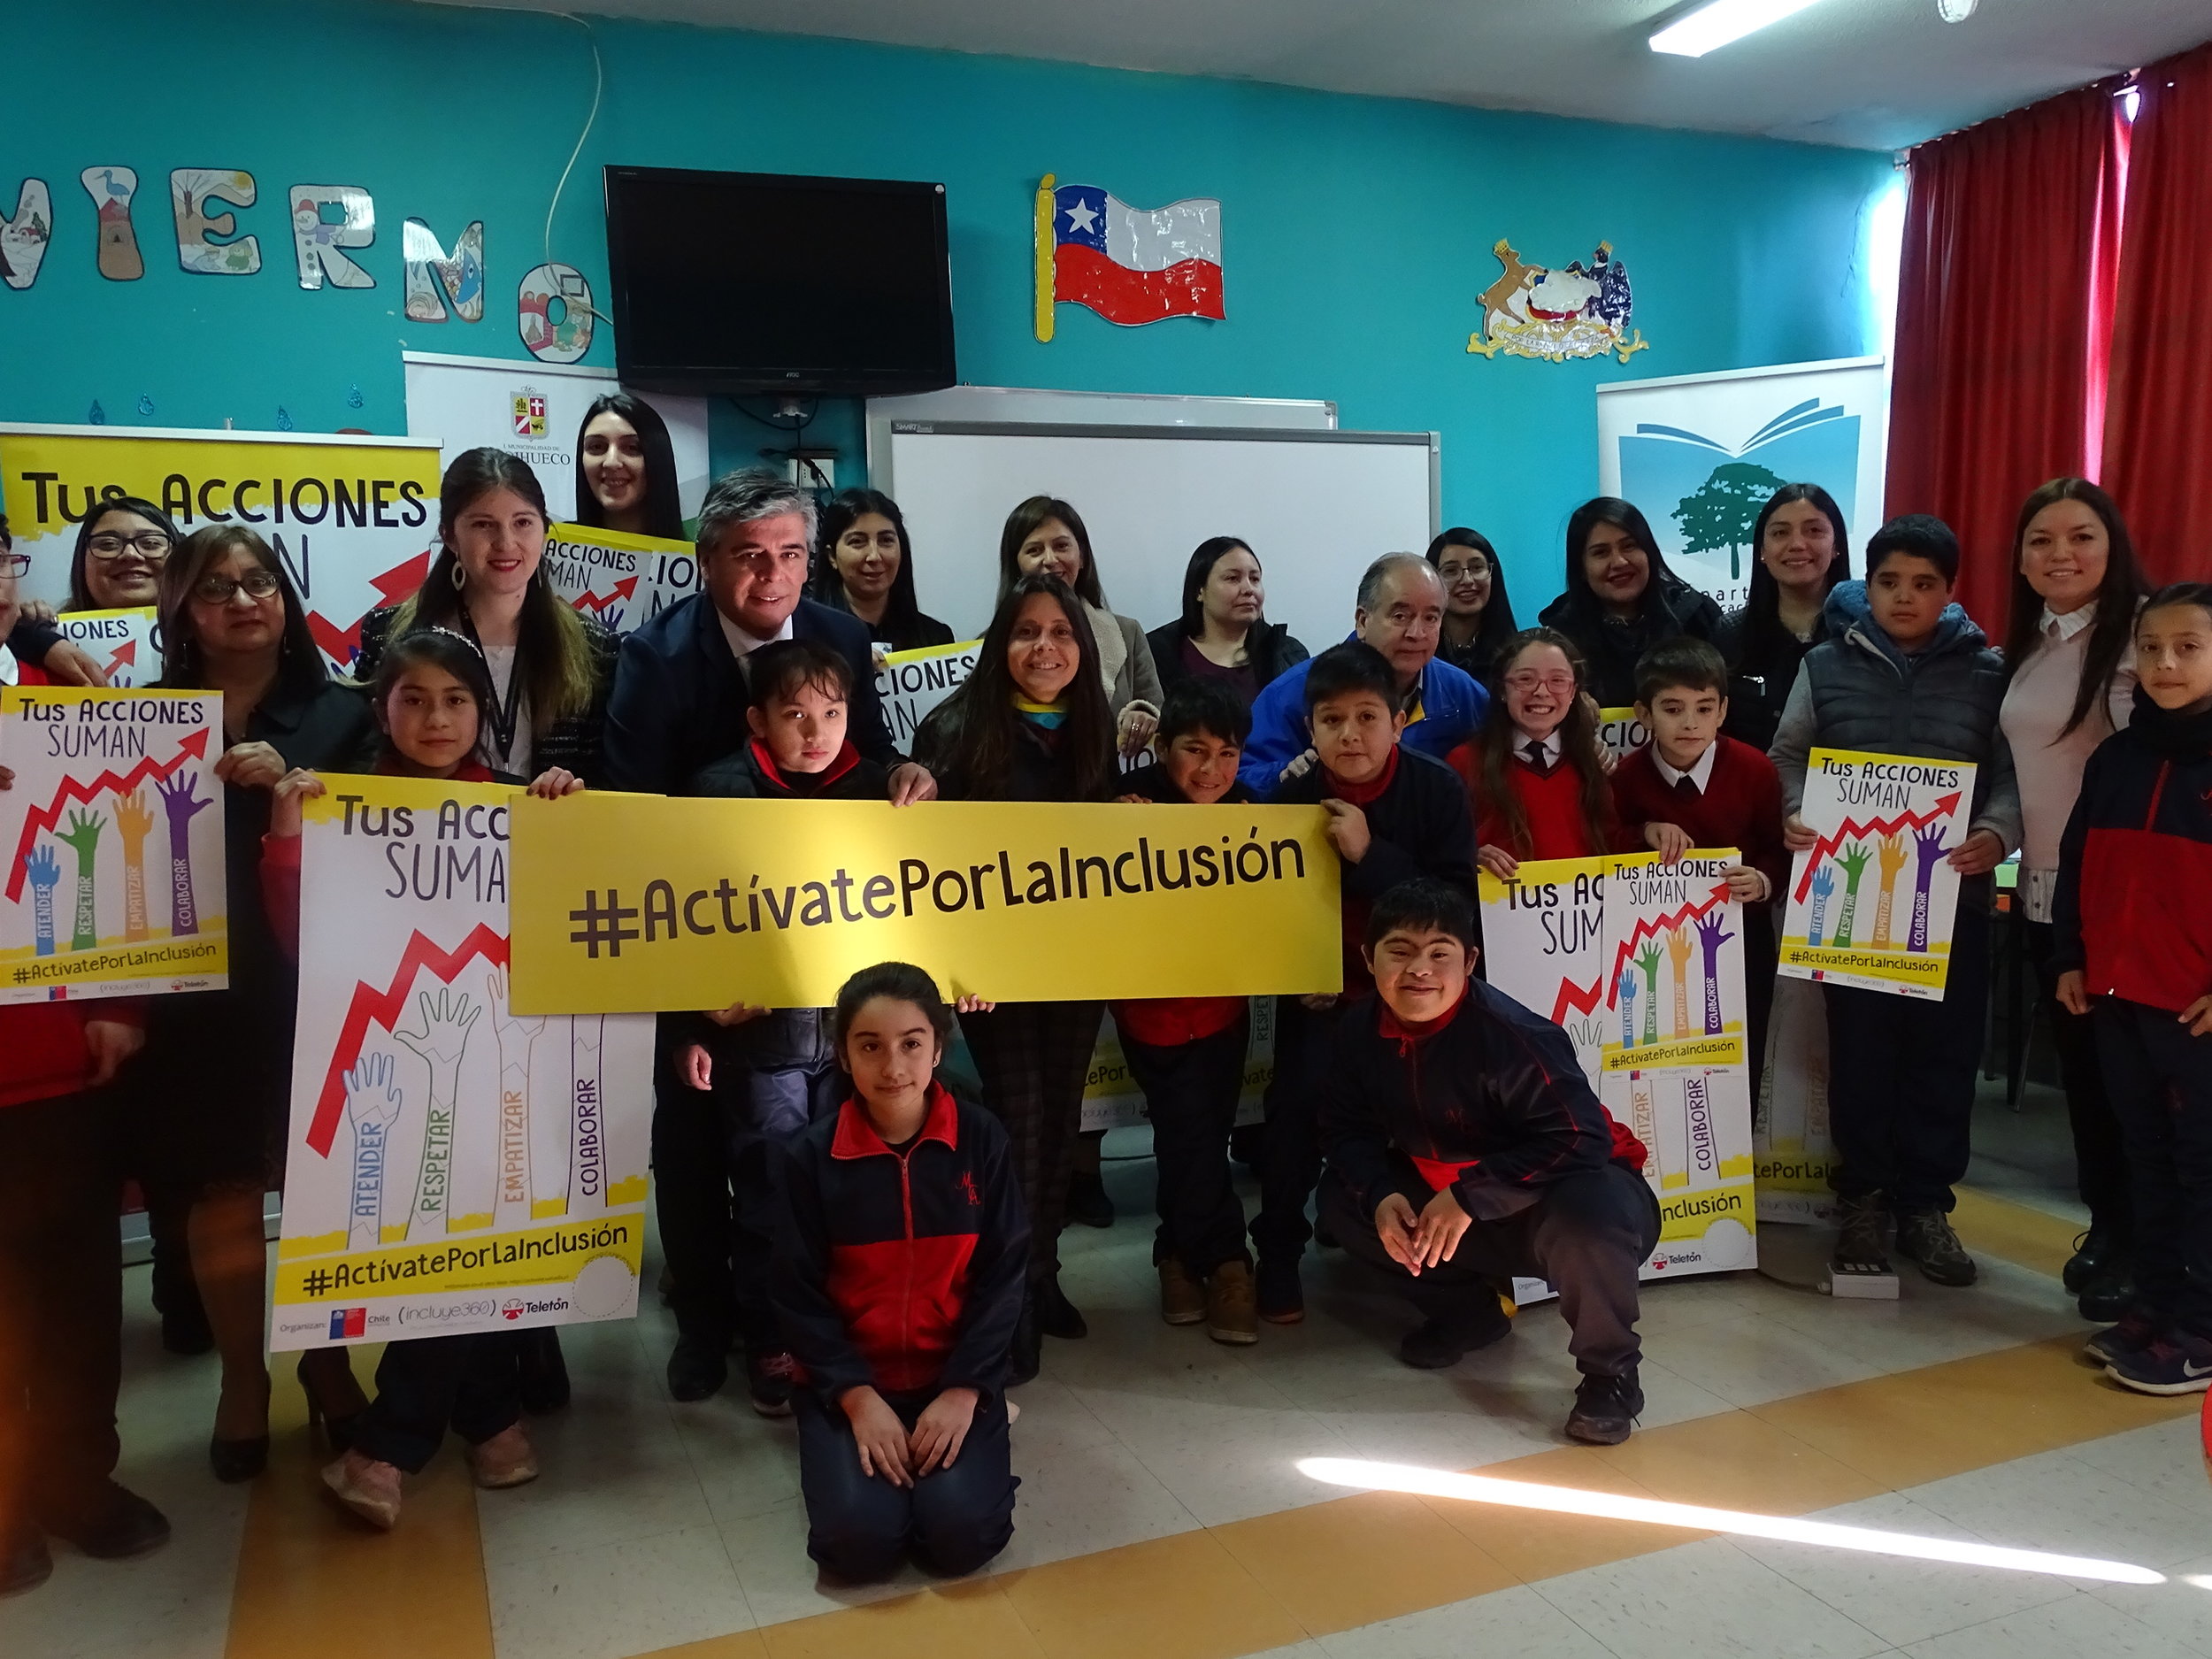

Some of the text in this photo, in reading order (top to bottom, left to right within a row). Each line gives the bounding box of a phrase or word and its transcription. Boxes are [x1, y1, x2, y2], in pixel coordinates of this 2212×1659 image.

[162, 474, 428, 527] ACCIONES
[545, 538, 637, 572] ACCIONES
[19, 698, 204, 725] Tus ACCIONES
[48, 724, 145, 758] SUMAN
[1821, 757, 1959, 788] Tus ACCIONES
[1837, 778, 1911, 810] SUMAN
[336, 795, 414, 837] Tus
[173, 858, 193, 927] COLABORAR
[569, 826, 1305, 960] #ActívatePorLaInclusión
[1502, 879, 1559, 910] Tus
[1614, 864, 1639, 880] Tus
[1629, 879, 1686, 905] SUMAN
[37, 884, 51, 939] ATENDER
[77, 875, 93, 935] RESPETAR
[127, 864, 142, 930] EMPATIZAR
[1811, 894, 1826, 934] ATENDER
[1839, 893, 1856, 938] RESPETAR
[1877, 891, 1892, 941] EMPATIZAR
[1914, 891, 1928, 946] COLABORAR
[1647, 990, 1655, 1034] RESPETAR
[1676, 983, 1686, 1030] EMPATIZAR
[1705, 977, 1718, 1029] COLABORAR
[503, 1090, 525, 1203] EMPATIZAR
[576, 1079, 599, 1196] COLABORAR
[1687, 1079, 1711, 1171] COLABORAR
[355, 1122, 382, 1216] ATENDER
[420, 1109, 450, 1211] RESPETAR
[303, 1223, 628, 1297] #ActívatePorLaInclusión
[1668, 1251, 1701, 1264] Teletón
[526, 1297, 569, 1314] Teletón
